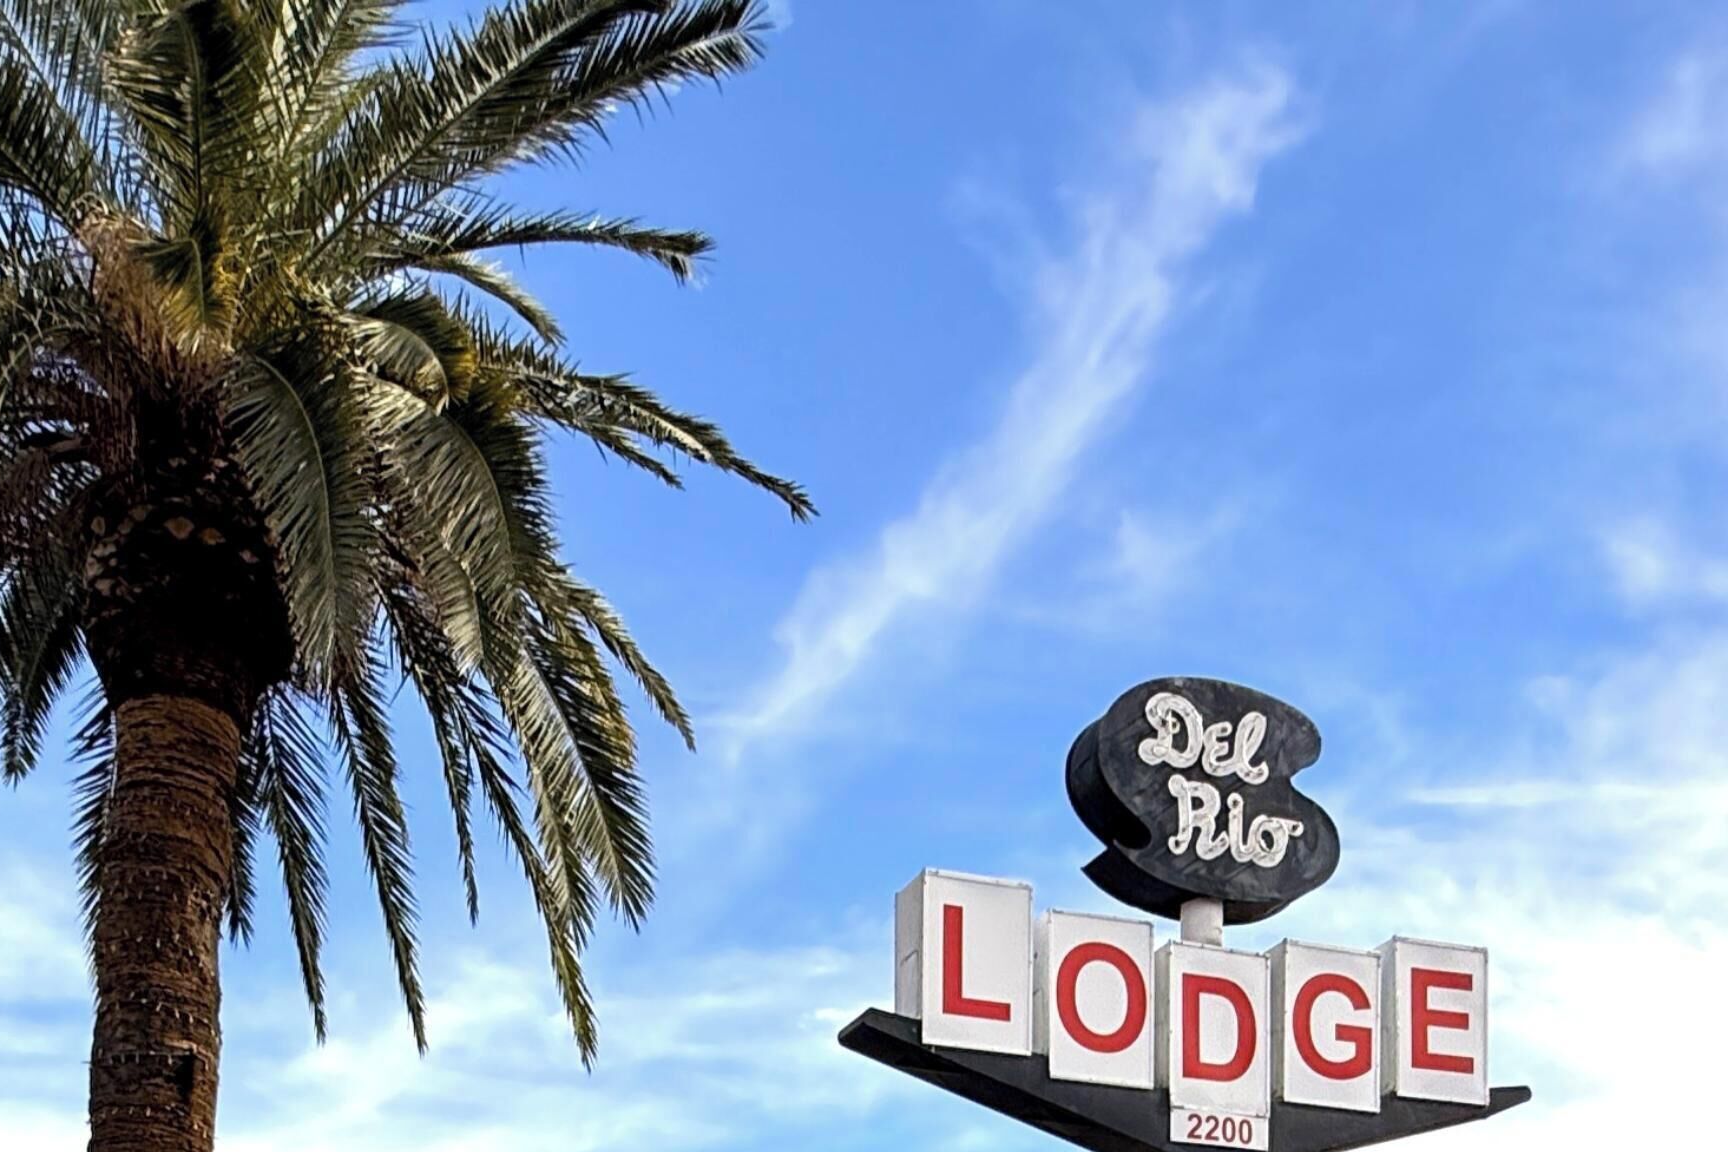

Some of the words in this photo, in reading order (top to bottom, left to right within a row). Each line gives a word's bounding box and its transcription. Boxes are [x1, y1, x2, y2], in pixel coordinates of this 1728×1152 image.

[1138, 692, 1270, 785] Del
[1168, 774, 1305, 868] Rio
[943, 903, 1474, 1082] LODGE
[1186, 1112, 1254, 1146] 2200
